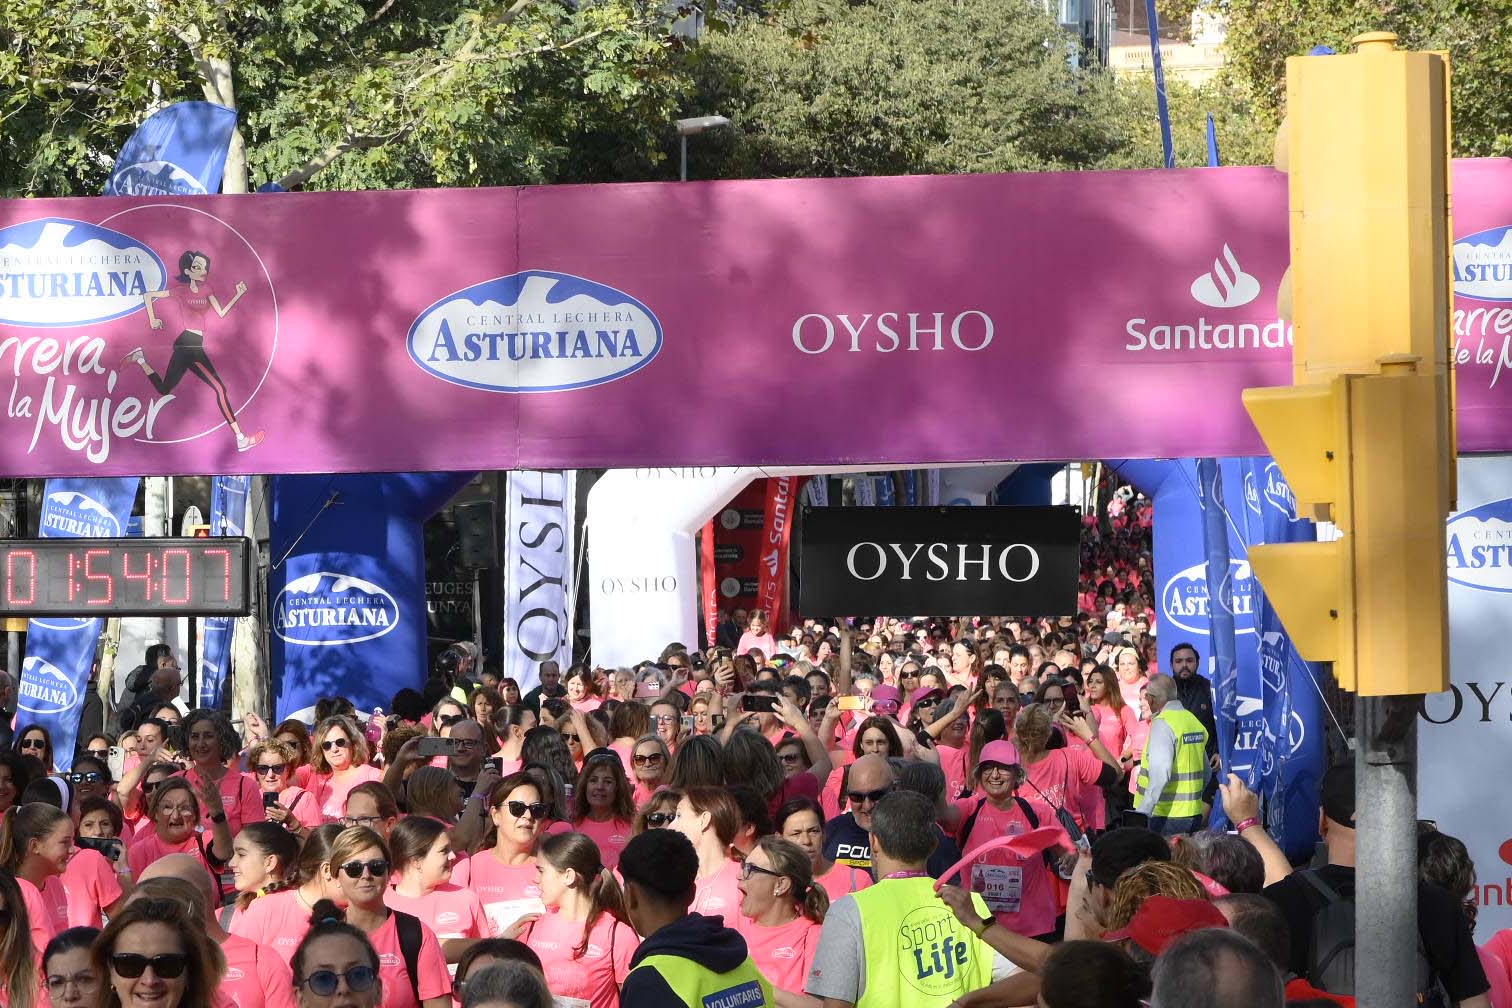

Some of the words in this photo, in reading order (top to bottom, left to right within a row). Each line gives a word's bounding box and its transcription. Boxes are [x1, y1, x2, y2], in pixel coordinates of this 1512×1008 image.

[467, 313, 545, 325] CENTRAL
[553, 312, 635, 323] LECHERA
[791, 310, 995, 355] OYSHO
[1126, 317, 1295, 351] Santand
[426, 318, 643, 362] ASTURIANA
[7, 381, 33, 419] la
[28, 367, 176, 464] Mujer
[44, 513, 111, 537] STURIANA
[7, 549, 230, 605] 01:54:07
[516, 469, 565, 662] OYSH
[846, 541, 1040, 582] OYSHO
[289, 597, 331, 605] CENTRAL
[336, 596, 384, 605] LECHERA
[601, 575, 677, 595] OYSHO
[277, 603, 390, 629] ASTURIANA
[1417, 682, 1512, 724] OY
[900, 914, 957, 951] Sport
[914, 936, 968, 980] Life
